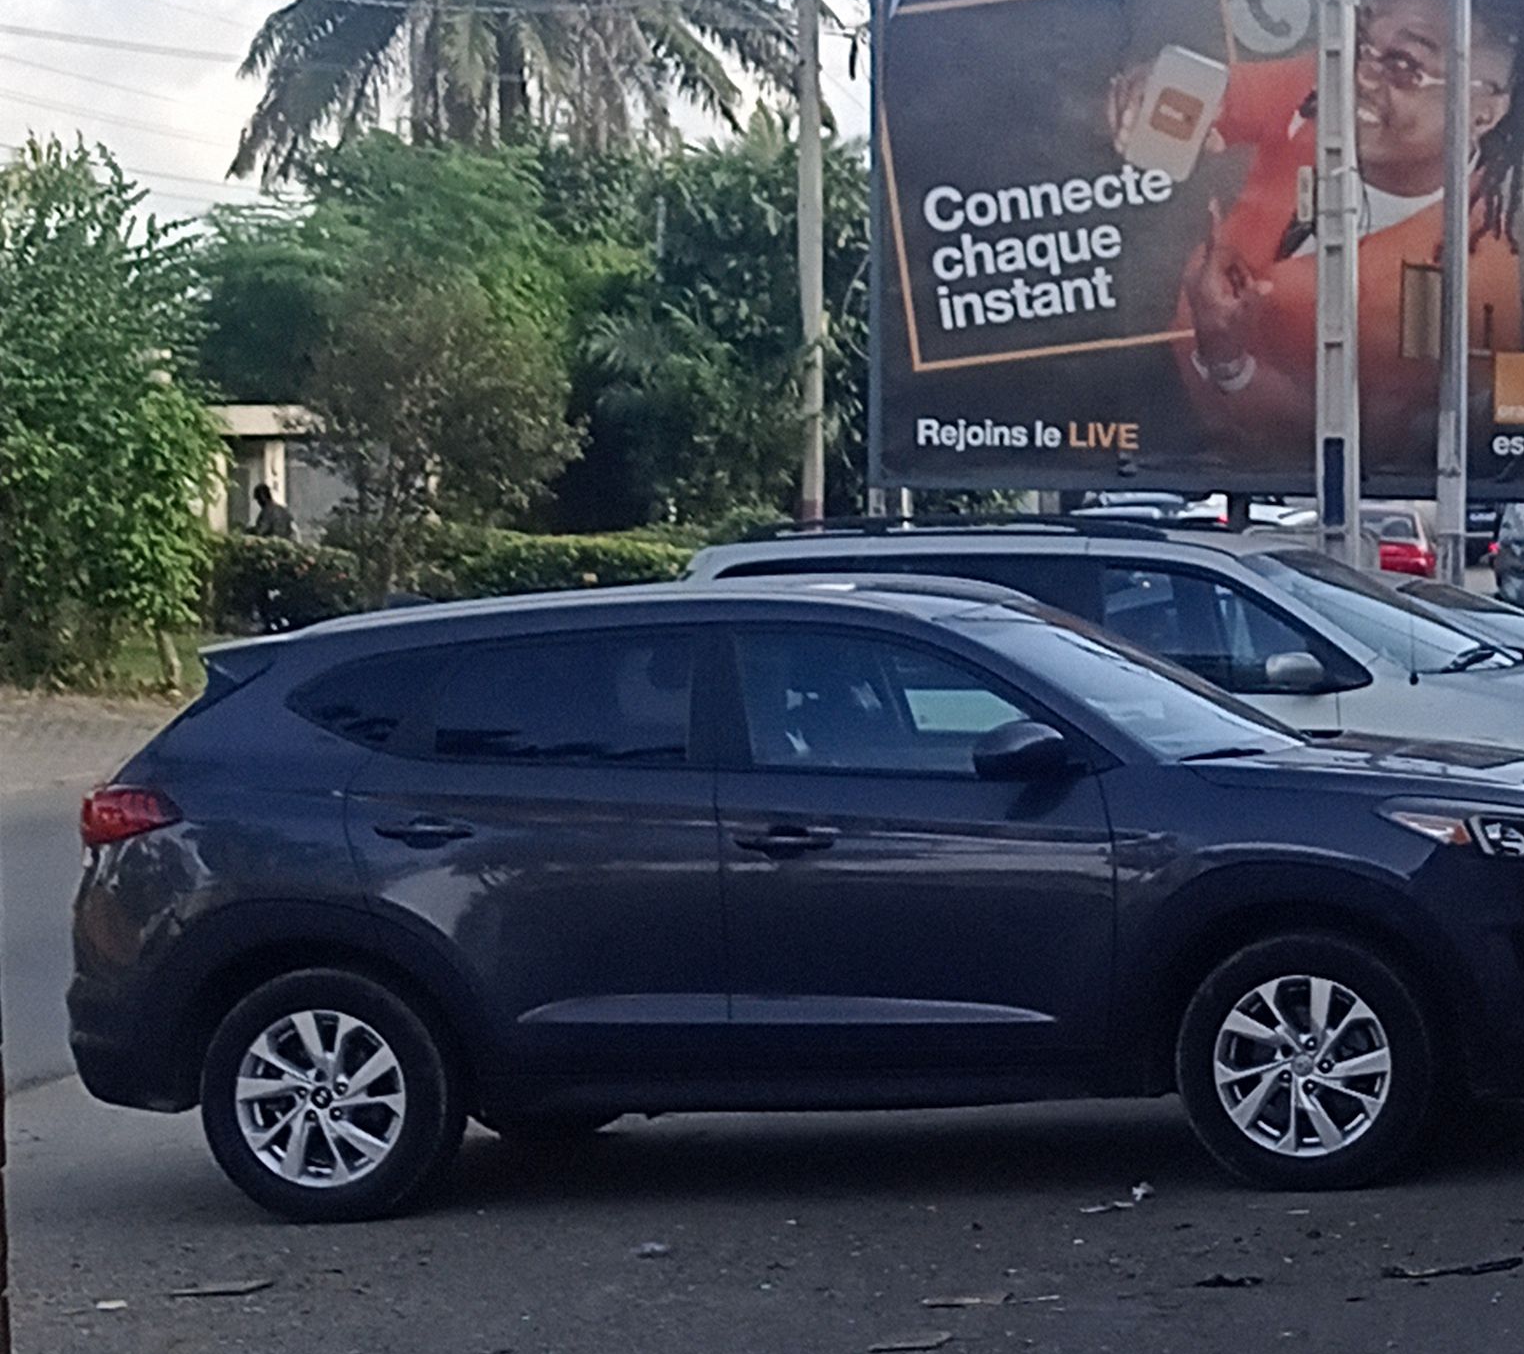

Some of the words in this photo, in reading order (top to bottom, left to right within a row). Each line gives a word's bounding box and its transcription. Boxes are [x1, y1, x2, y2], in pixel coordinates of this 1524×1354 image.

[923, 164, 1173, 232] Connecte
[932, 224, 1122, 281] chaque
[936, 266, 1116, 330] instant
[916, 418, 1029, 451] Rejoins
[1035, 420, 1061, 447] le
[1068, 421, 1140, 449] LIVE
